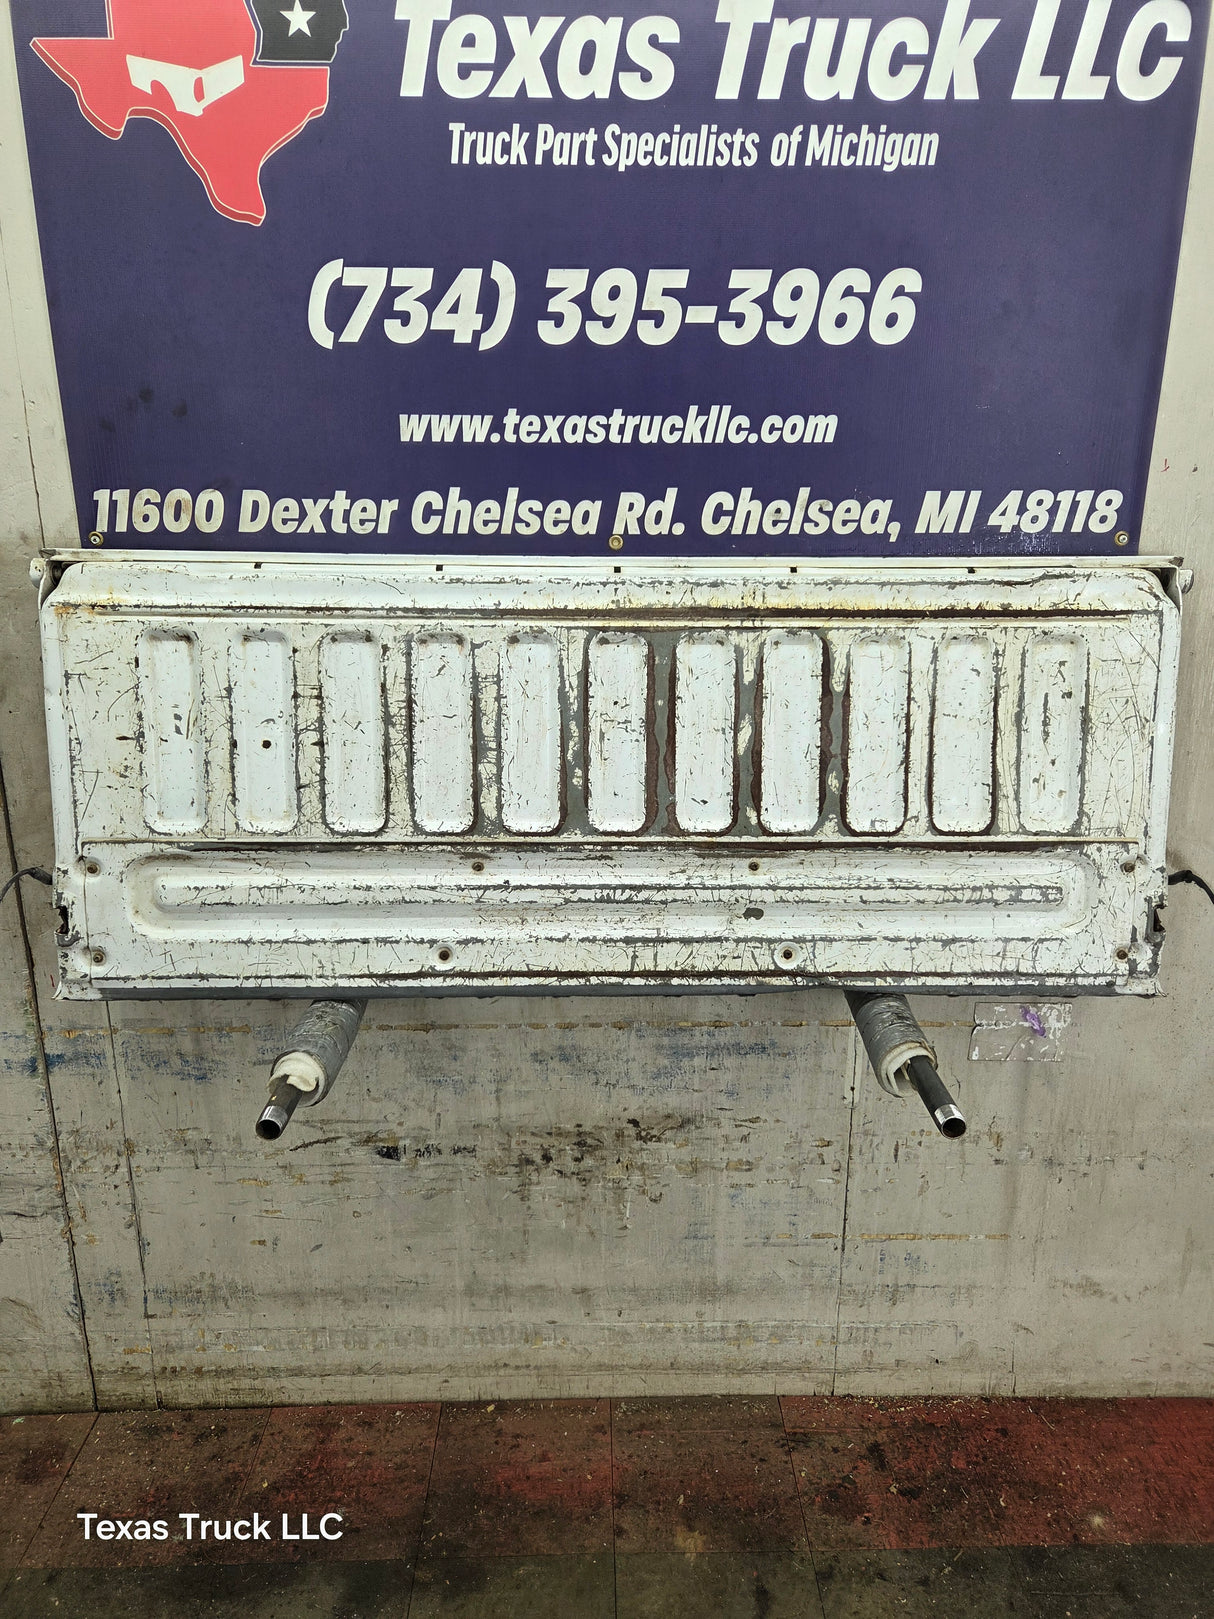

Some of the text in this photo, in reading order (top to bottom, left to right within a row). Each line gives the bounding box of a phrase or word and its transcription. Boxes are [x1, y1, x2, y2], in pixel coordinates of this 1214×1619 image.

[394, 0, 1192, 101] Texas Truck LLC
[449, 123, 939, 172] Truck Part Specialists of Michigan
[308, 259, 923, 351] (734) 395-3966
[399, 405, 838, 443] www.texastruckllc.com
[93, 487, 1123, 542] 11600 Dexter Chelsea Rd. Chelsea, MI 48118
